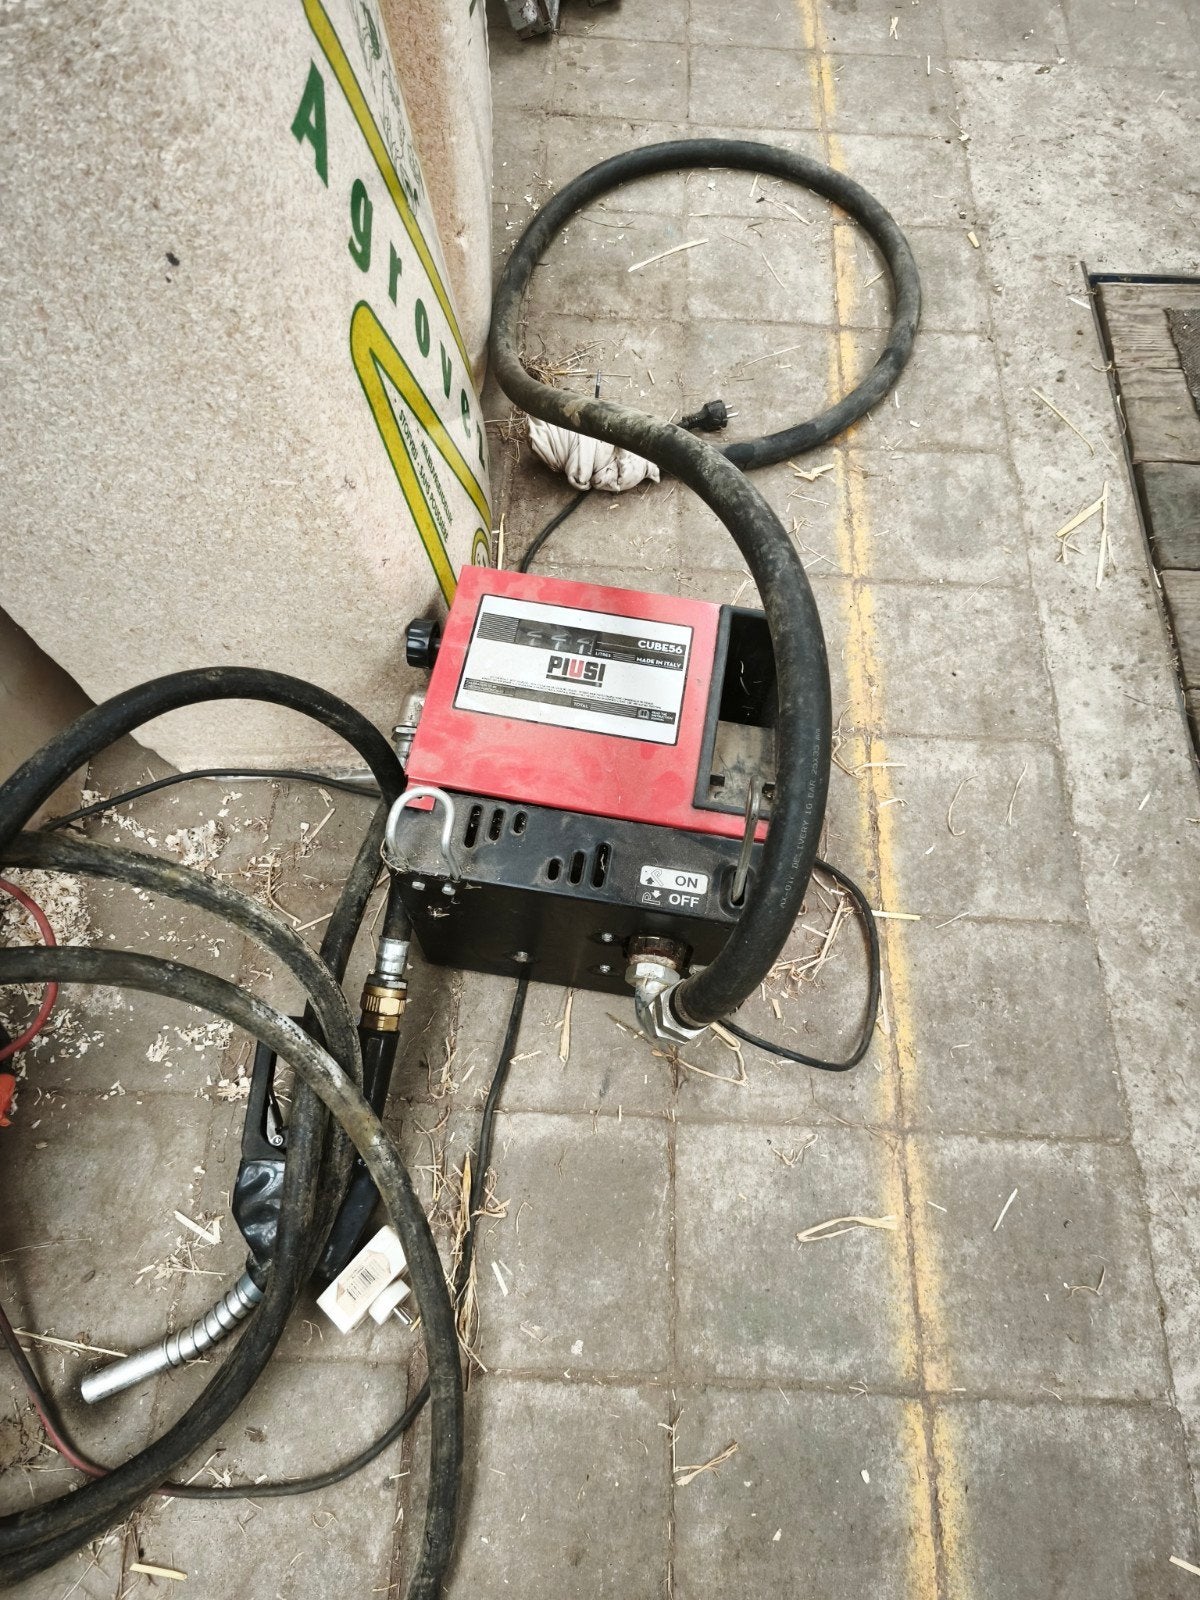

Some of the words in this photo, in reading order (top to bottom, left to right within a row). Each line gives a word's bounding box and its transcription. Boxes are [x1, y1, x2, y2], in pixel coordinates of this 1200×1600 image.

[637, 640, 683, 654] CUBE56
[636, 656, 655, 664] MADE
[547, 655, 606, 682] PIUSI
[675, 875, 699, 889] ON
[668, 893, 700, 908] OFF
